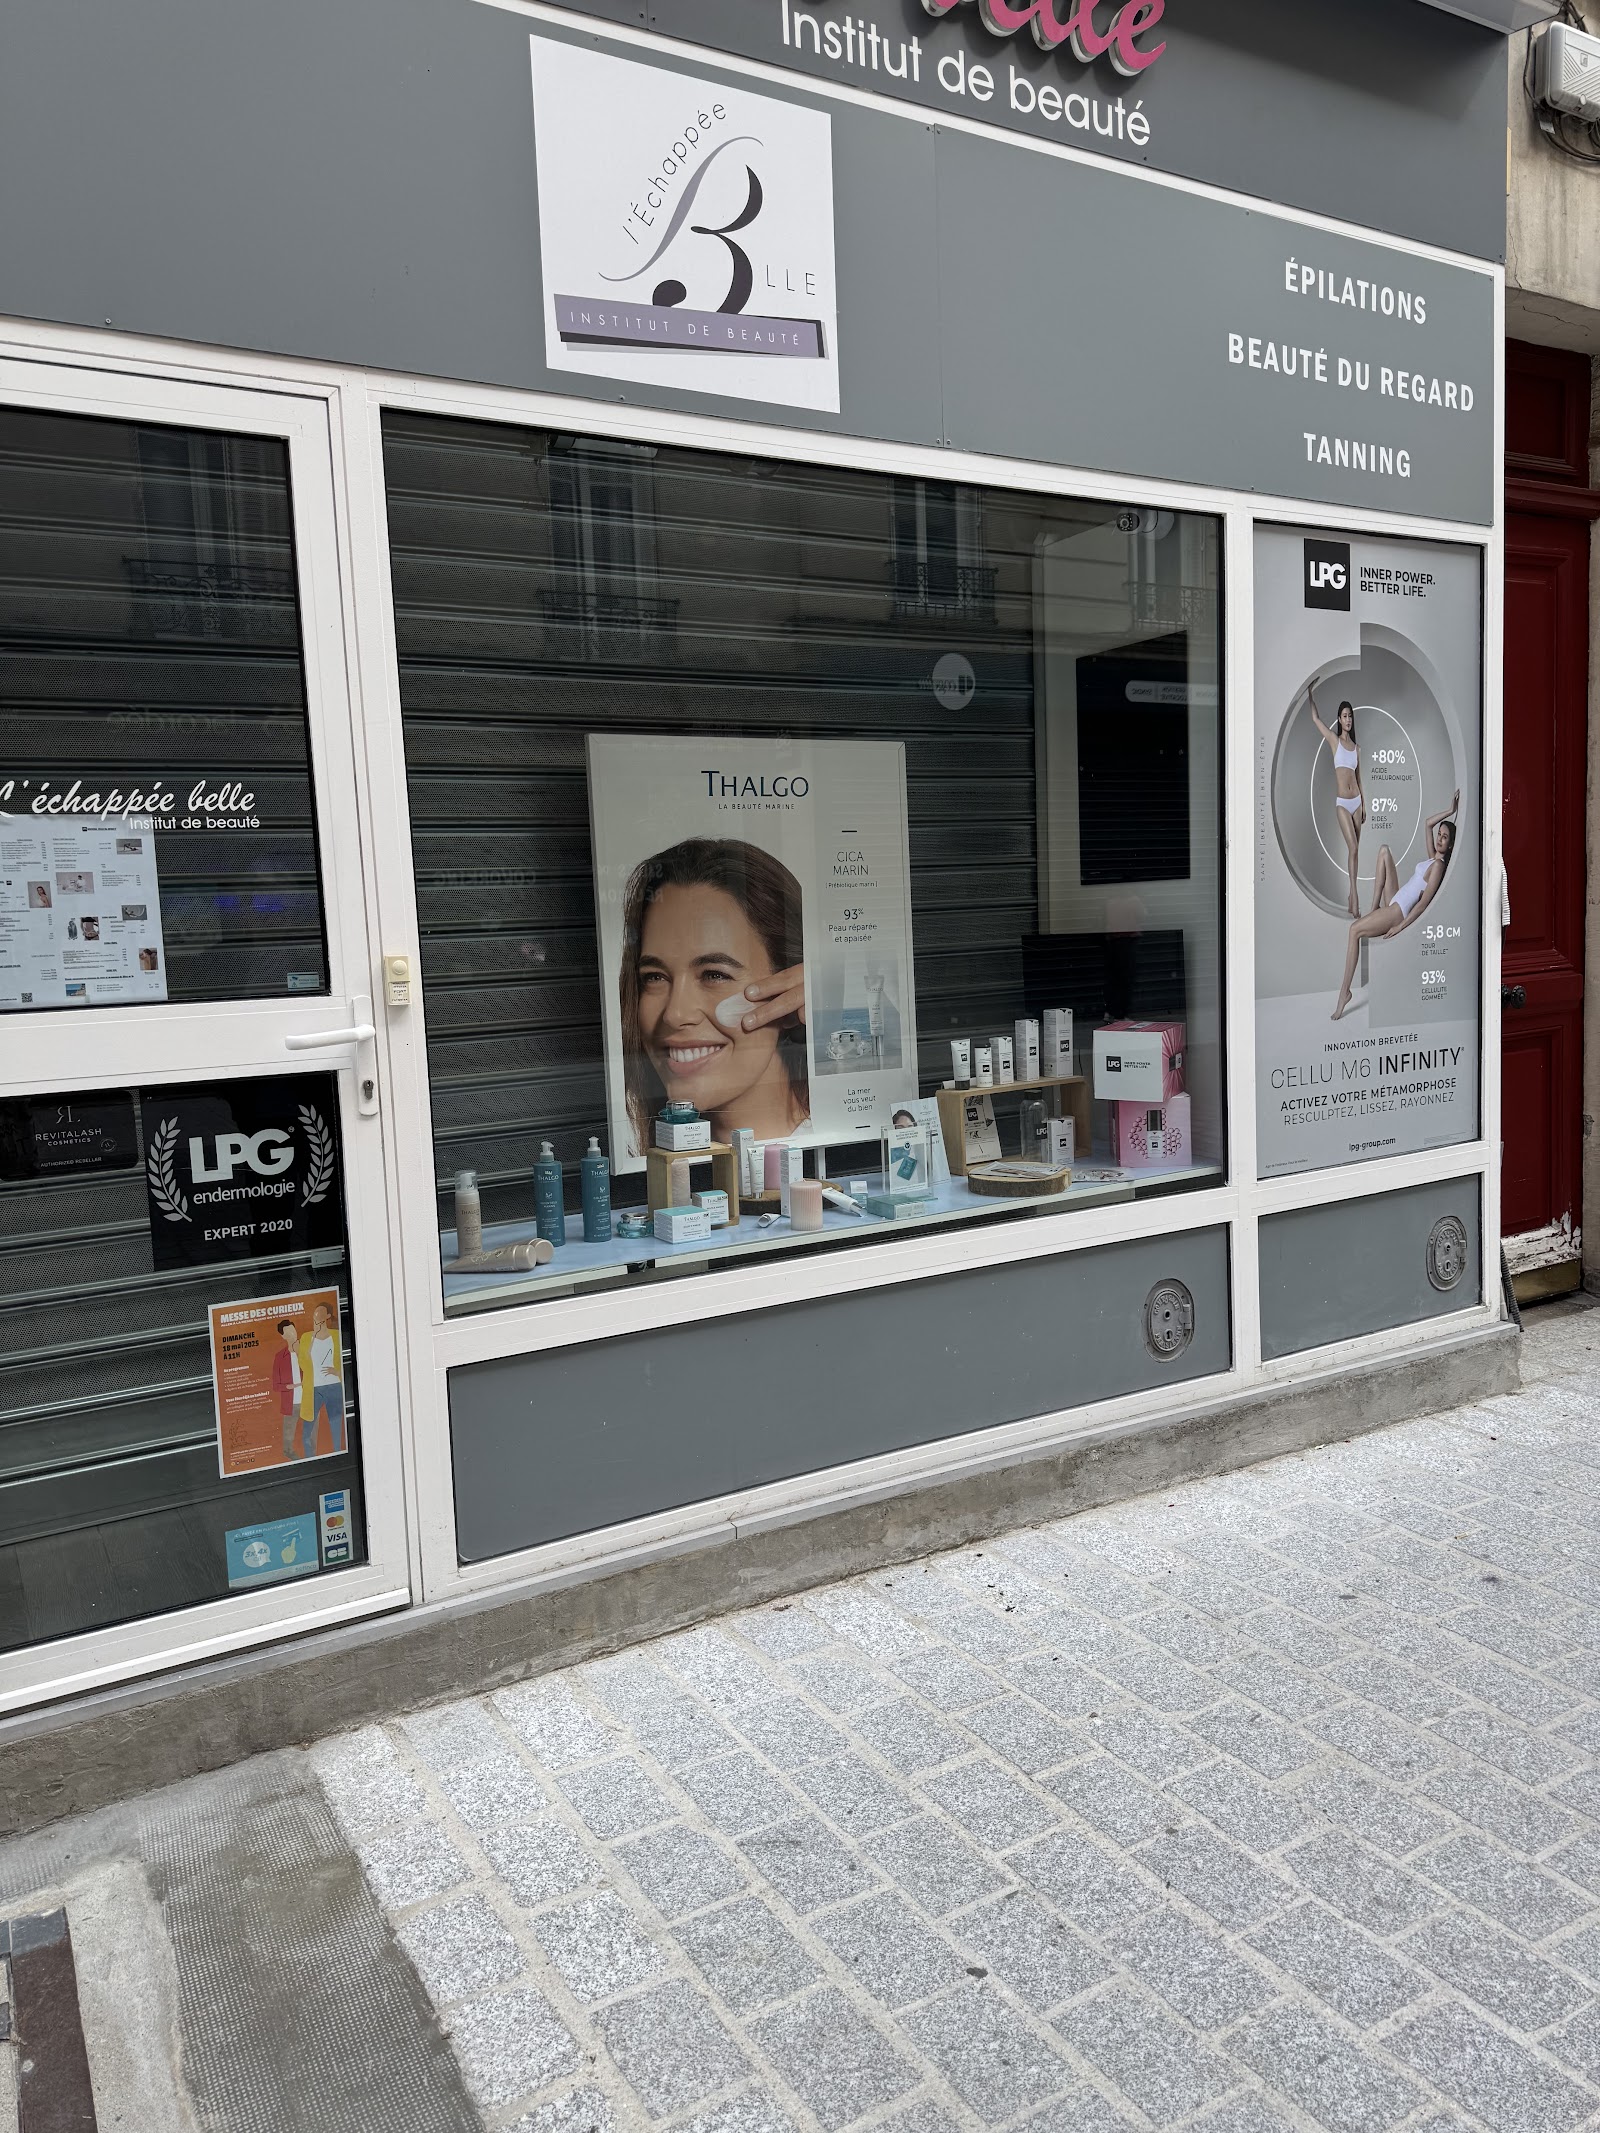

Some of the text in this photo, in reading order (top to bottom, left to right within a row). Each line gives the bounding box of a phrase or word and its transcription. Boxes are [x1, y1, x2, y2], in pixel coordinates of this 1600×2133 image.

[781, 0, 922, 82] Institut
[937, 50, 995, 101] de
[1009, 64, 1150, 146] beauté
[1284, 257, 1427, 325] ÉPILATIONS
[570, 311, 799, 345] INSTITUT DE BEAUTÉ
[1228, 332, 1474, 412] BEAUTÉ DU REGARD
[1303, 432, 1411, 478] TANNING
[1309, 560, 1347, 590] LPG
[1360, 566, 1436, 586] INNER POWER.
[1360, 580, 1427, 598] BETTER LIFE.
[1371, 749, 1406, 764] +80%
[701, 770, 809, 798] THALGO
[188, 780, 255, 811] belle
[1371, 798, 1398, 812] 87%
[130, 817, 176, 829] Institut
[181, 816, 201, 829] de
[206, 815, 260, 829] beauté
[836, 851, 864, 862] CICA
[833, 864, 869, 876] MARIN
[828, 923, 877, 932] Peau réparée
[1421, 924, 1461, 942] -5,8 CM
[834, 934, 872, 944] et apaisée
[1421, 969, 1446, 985] 93%
[1324, 1033, 1419, 1052] INNOVATION BREVETÉE
[1271, 1062, 1334, 1089] CELLU
[1341, 1058, 1371, 1081] M6
[843, 1097, 860, 1105] vous
[847, 1088, 856, 1096] La
[1280, 1077, 1457, 1112] ACTIVEZ VOTRE MÉTAMORPHOSE
[847, 1104, 873, 1113] du bien
[1284, 1091, 1454, 1126] RESCULPTEZ, LISSEZ, RAYONNEZ
[35, 1128, 102, 1142] REVITALASH
[47, 1137, 91, 1147] COSMETICS
[1348, 1136, 1396, 1152] lpg-group.com
[193, 1179, 295, 1204] endermologie
[204, 1219, 293, 1241] EXPERT 2020
[221, 1302, 304, 1324] MESSE DES CURIEUX
[222, 1332, 255, 1343] DIMANCHE
[244, 1340, 259, 1349] 2025
[327, 1531, 348, 1542] VISA
